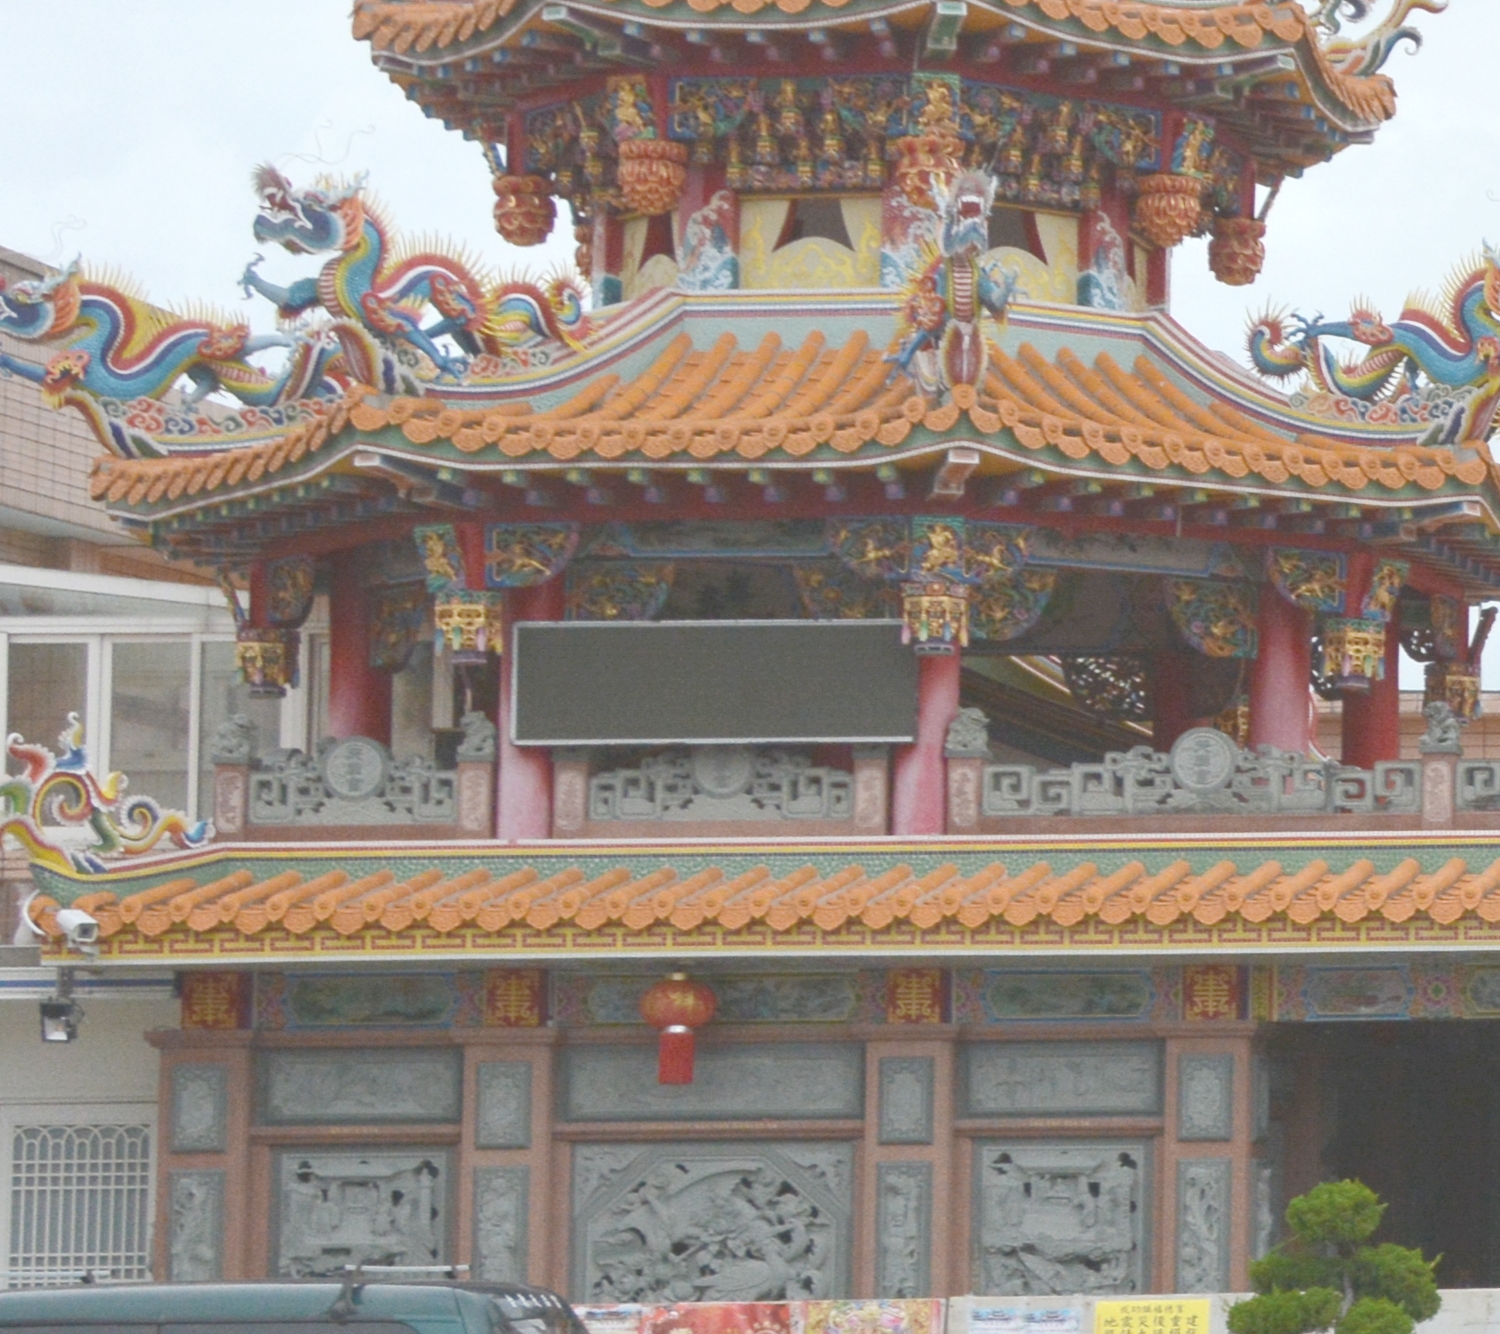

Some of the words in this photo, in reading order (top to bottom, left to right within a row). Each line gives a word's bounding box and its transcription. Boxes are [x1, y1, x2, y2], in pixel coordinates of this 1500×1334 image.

[1104, 1315, 1199, 1328] 地震災後重建
